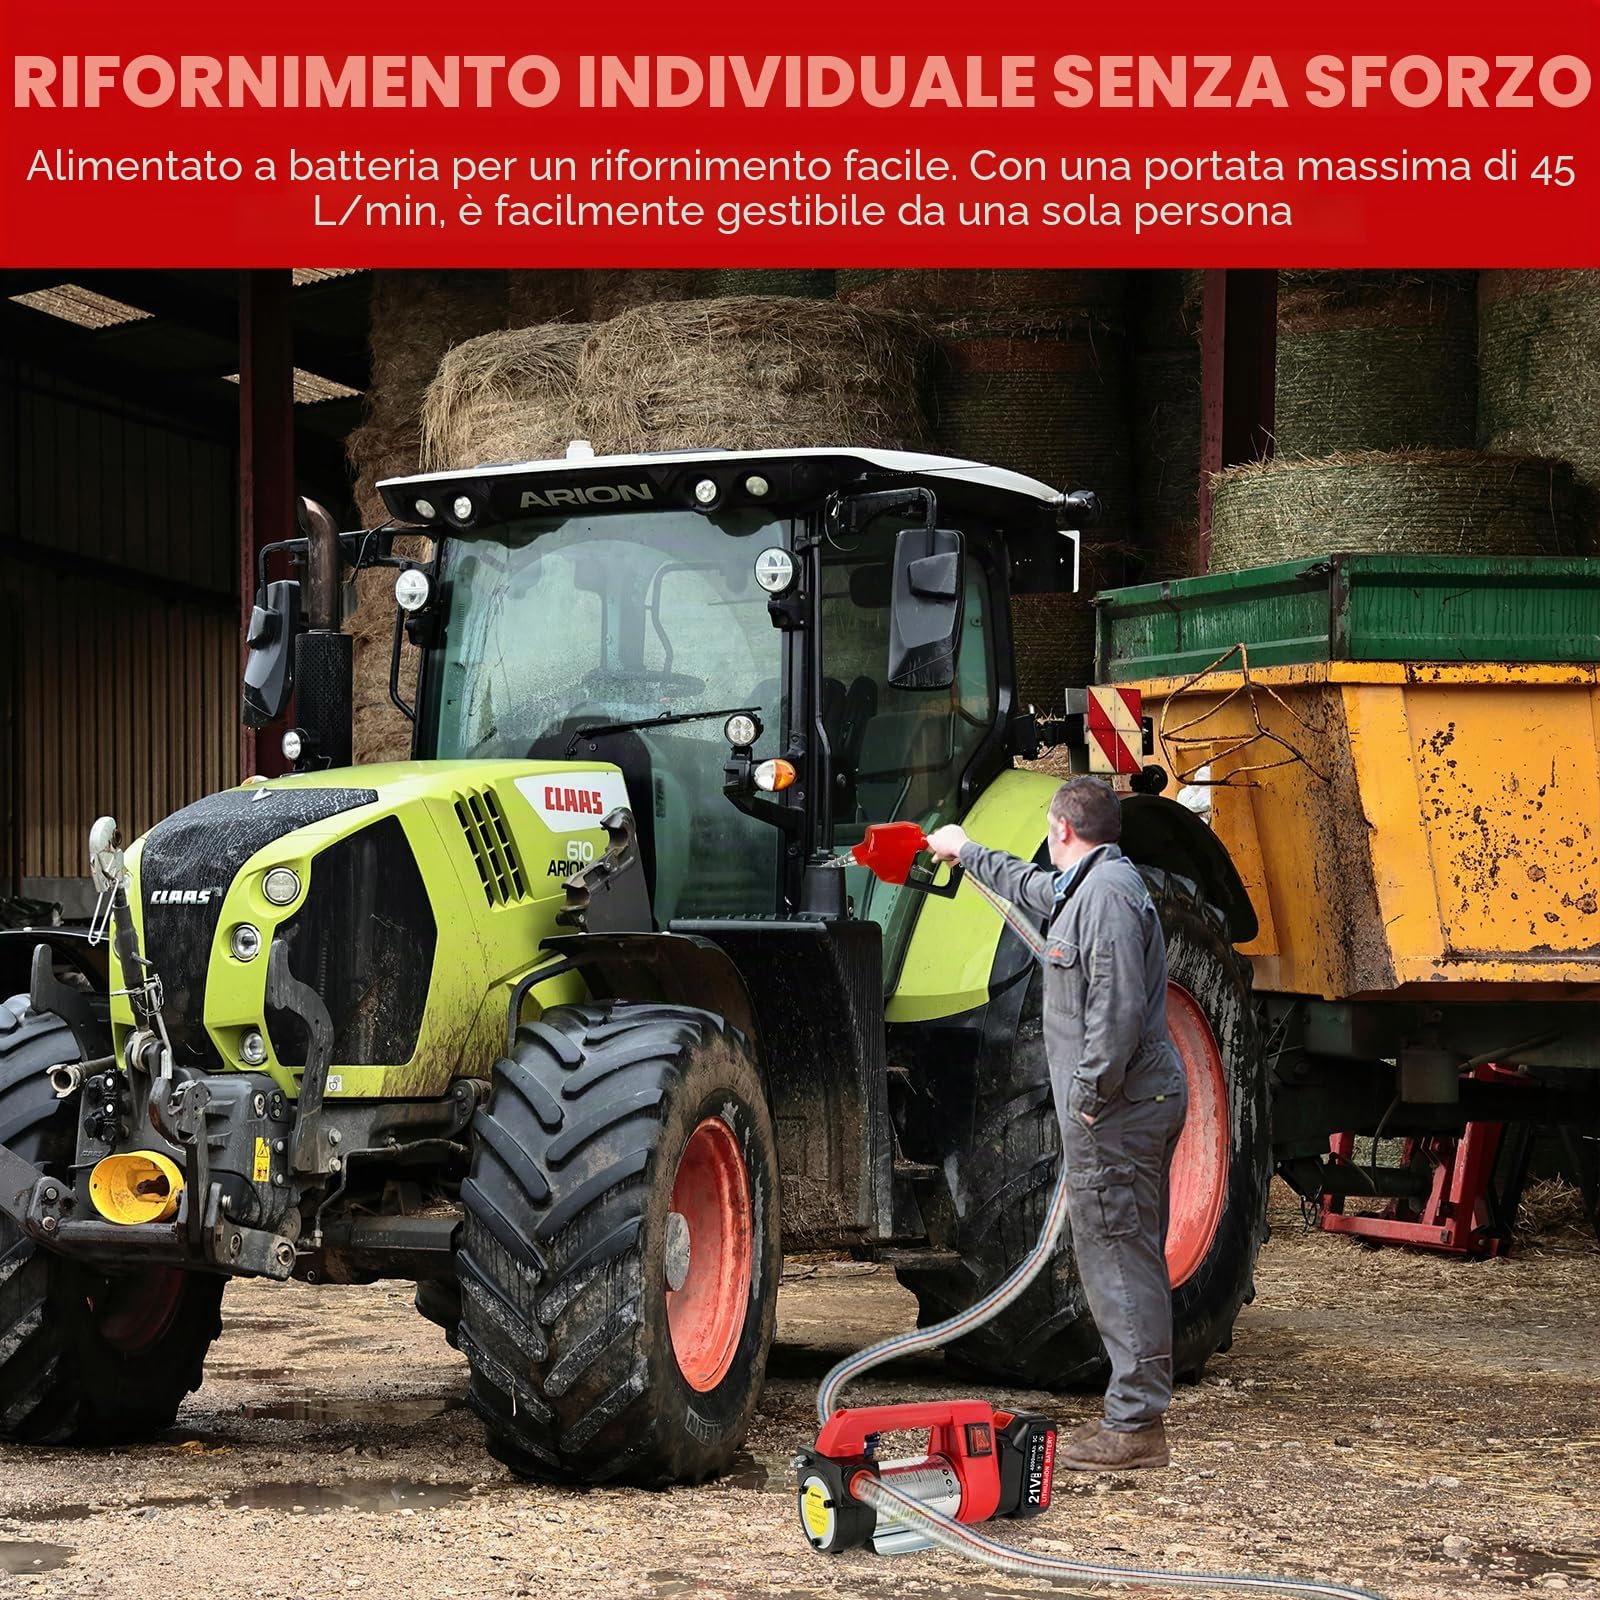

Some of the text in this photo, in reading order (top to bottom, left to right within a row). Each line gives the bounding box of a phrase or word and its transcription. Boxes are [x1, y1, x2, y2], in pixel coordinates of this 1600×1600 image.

[519, 483, 654, 508] ARION
[544, 786, 603, 815] CLAAS
[566, 840, 594, 862] 610
[150, 890, 212, 905] CLAAS
[1029, 1478, 1041, 1503] 21V
